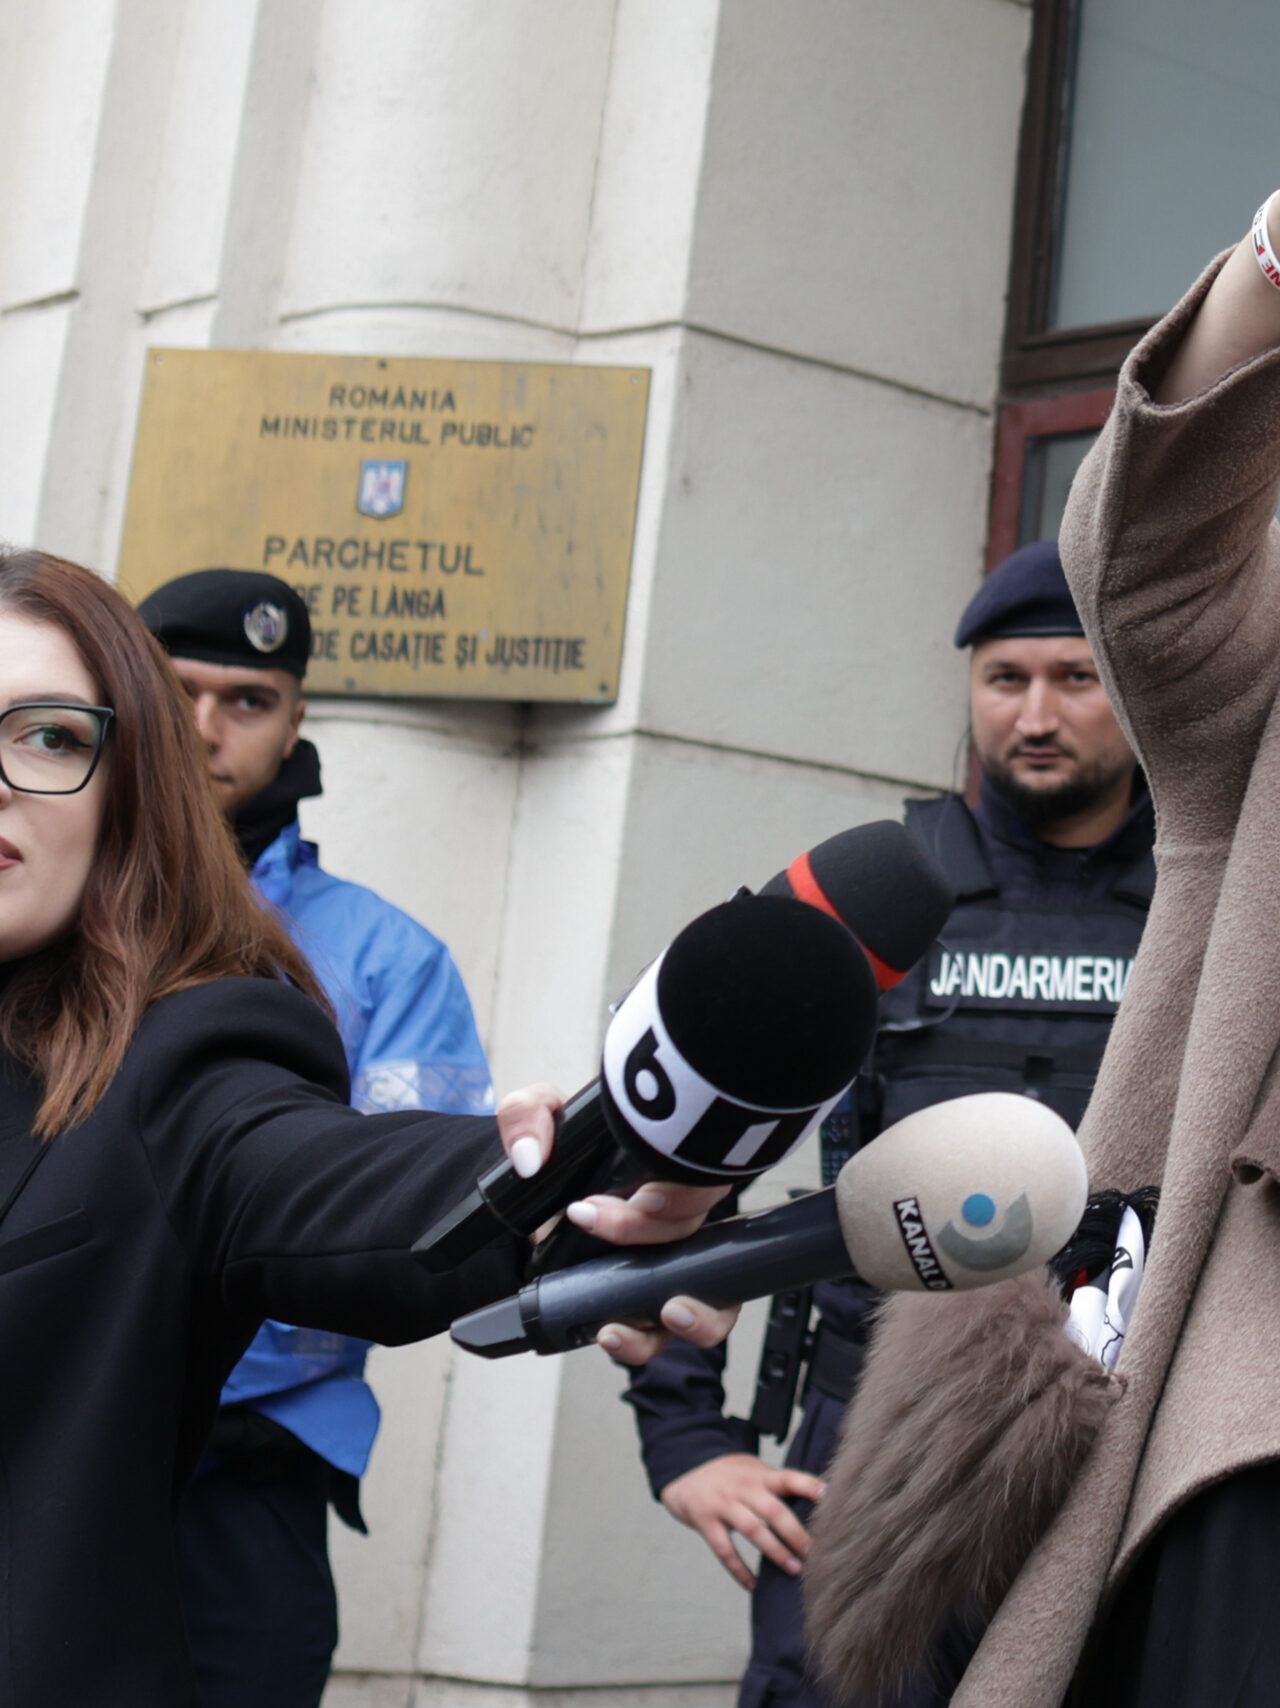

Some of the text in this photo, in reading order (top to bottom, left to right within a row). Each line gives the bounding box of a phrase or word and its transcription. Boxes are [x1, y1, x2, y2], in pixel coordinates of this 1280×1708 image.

[260, 416, 536, 448] MINISTERUL PUBLIC
[263, 536, 485, 576] PARCHETUL
[331, 585, 362, 617] PE
[310, 629, 340, 661] DE
[896, 1199, 940, 1279] KANAL
